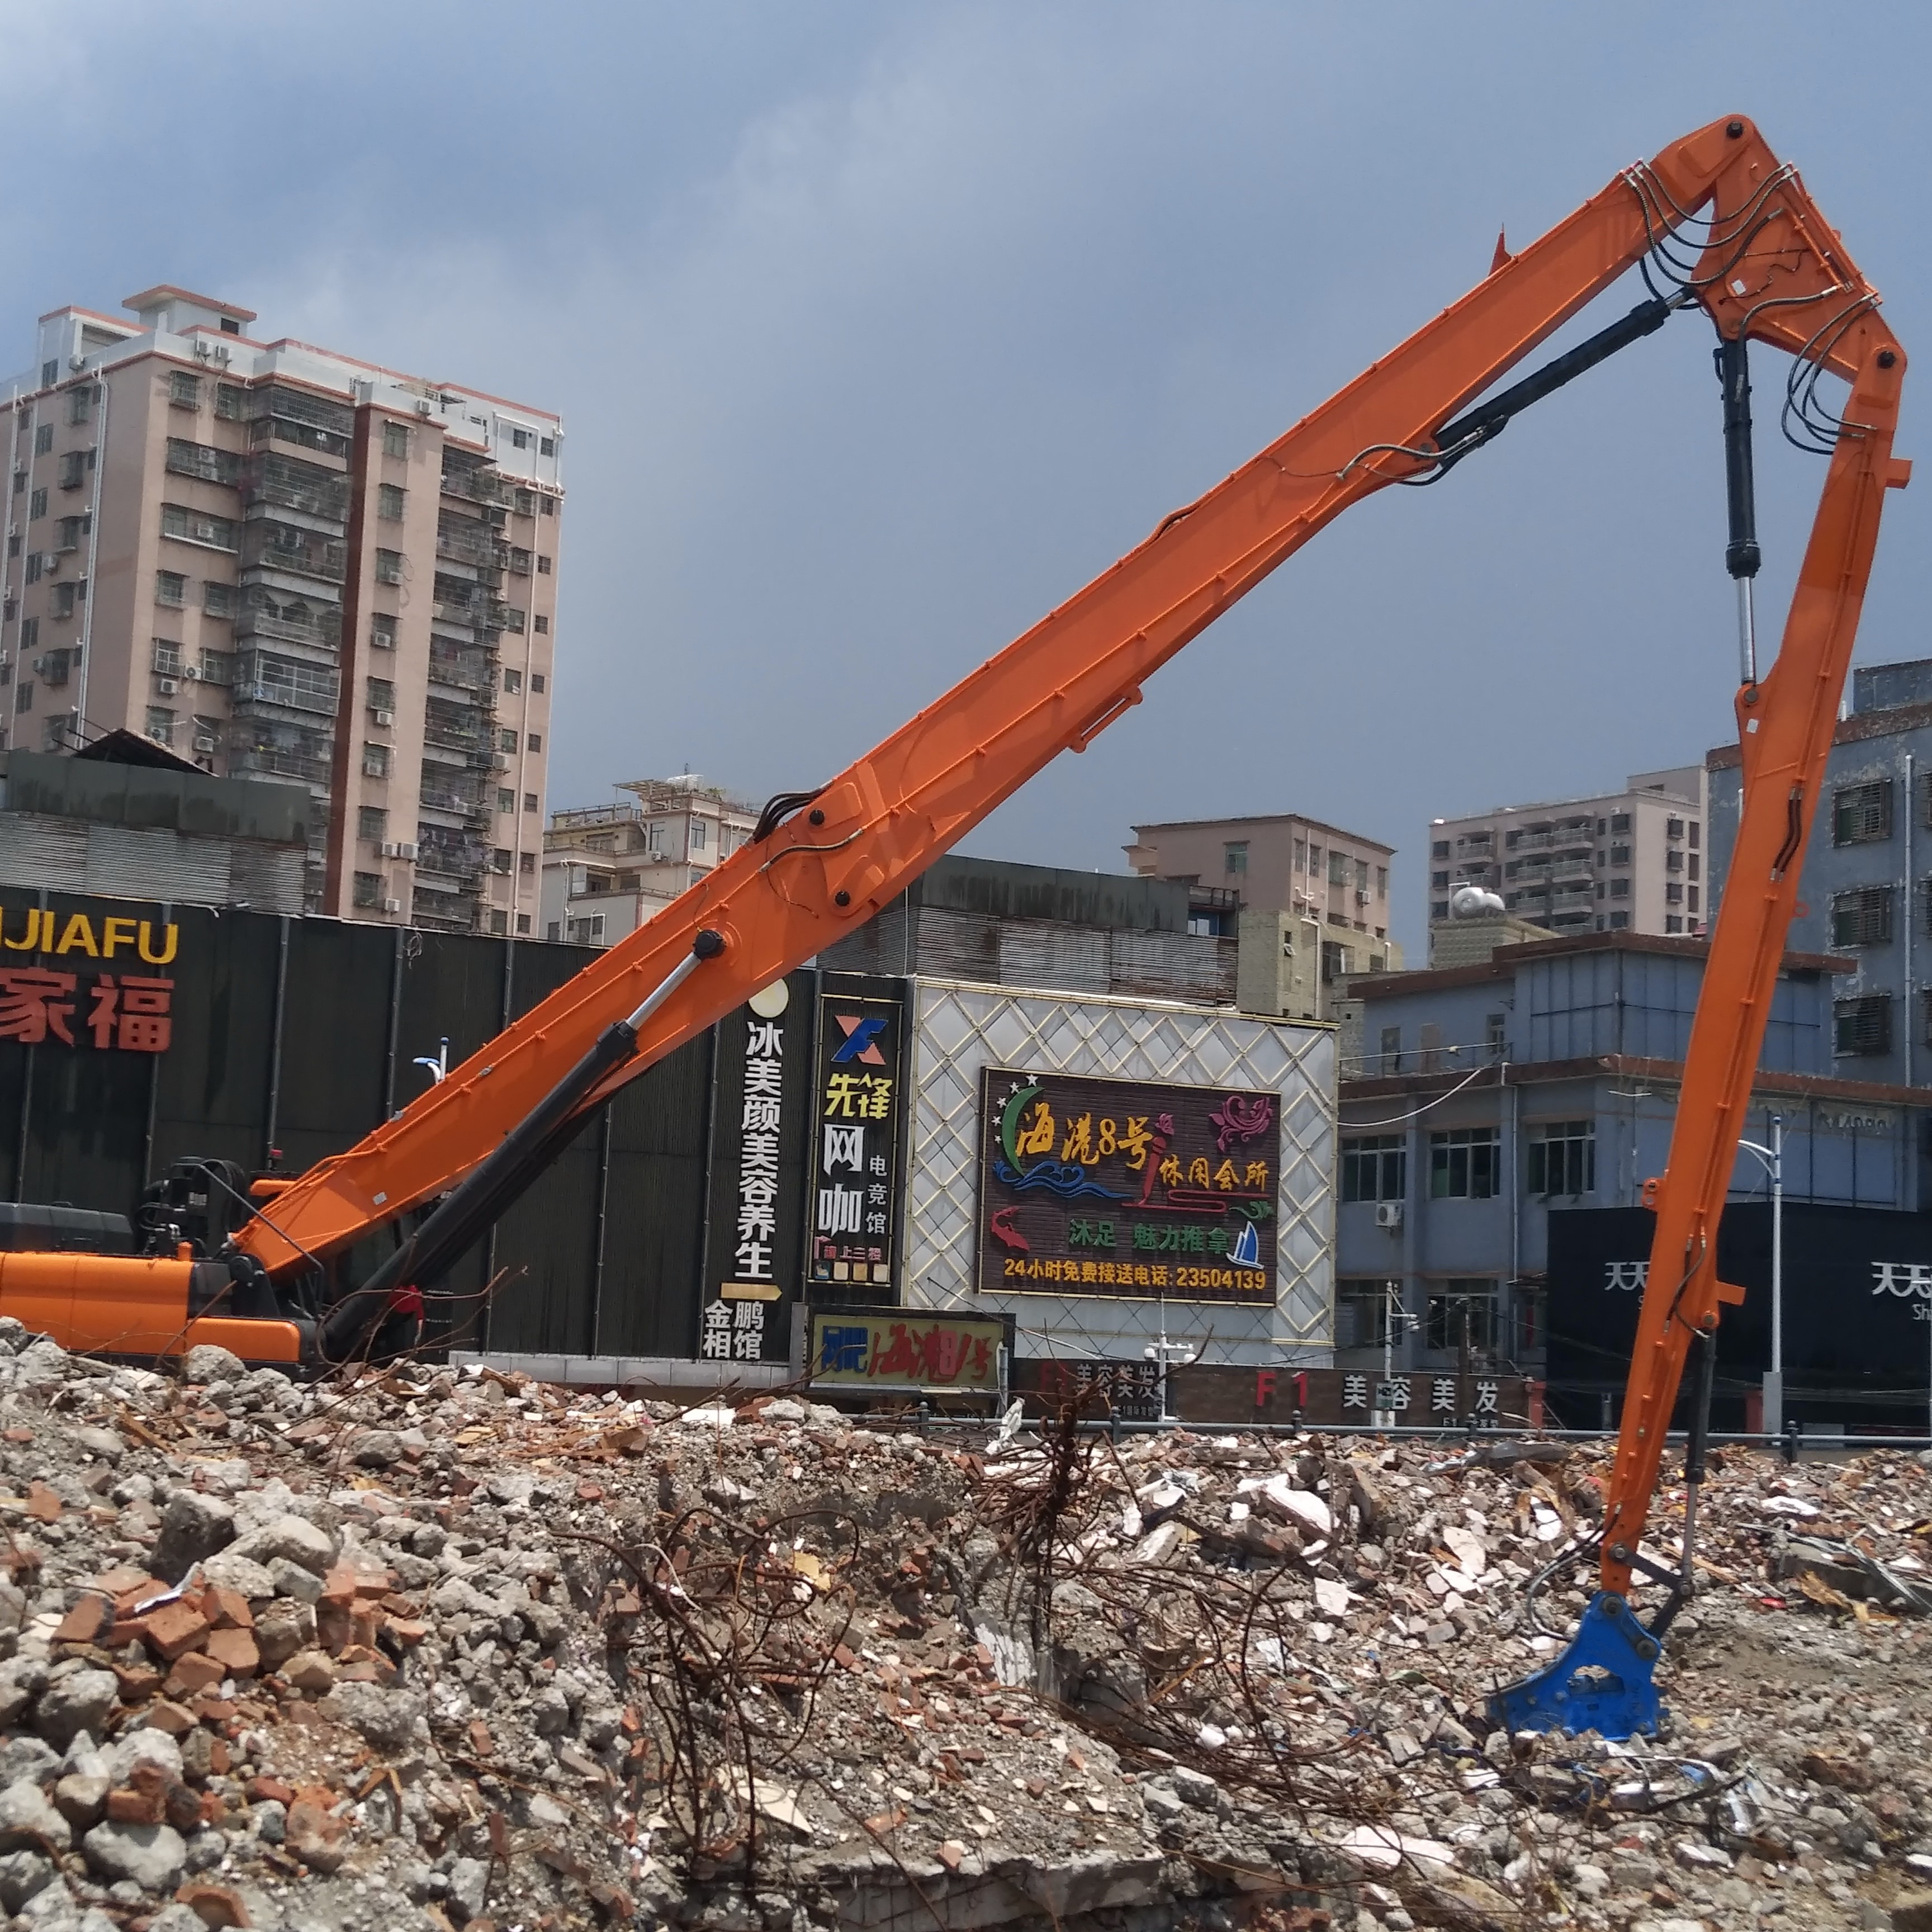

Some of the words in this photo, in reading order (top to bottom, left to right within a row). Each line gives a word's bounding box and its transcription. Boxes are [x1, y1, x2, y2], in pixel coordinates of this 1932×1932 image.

[0, 906, 179, 964] JIAFU
[0, 967, 174, 1052] 家福
[823, 1072, 893, 1119] 先锋
[734, 1021, 784, 1279] 冰美颜美容养生
[817, 1123, 865, 1237] 网咖
[865, 1154, 888, 1235] 电竞馆
[1159, 1154, 1270, 1192] 休闲会所
[1069, 1218, 1116, 1247] 沐足
[1133, 1222, 1230, 1254] 魅力推拿
[704, 1299, 764, 1330] 金鹏
[703, 1329, 763, 1360] 相馆
[1076, 1363, 1156, 1398] 美容美发
[1256, 1371, 1309, 1407] F1
[1343, 1374, 1499, 1413] 美容美发
